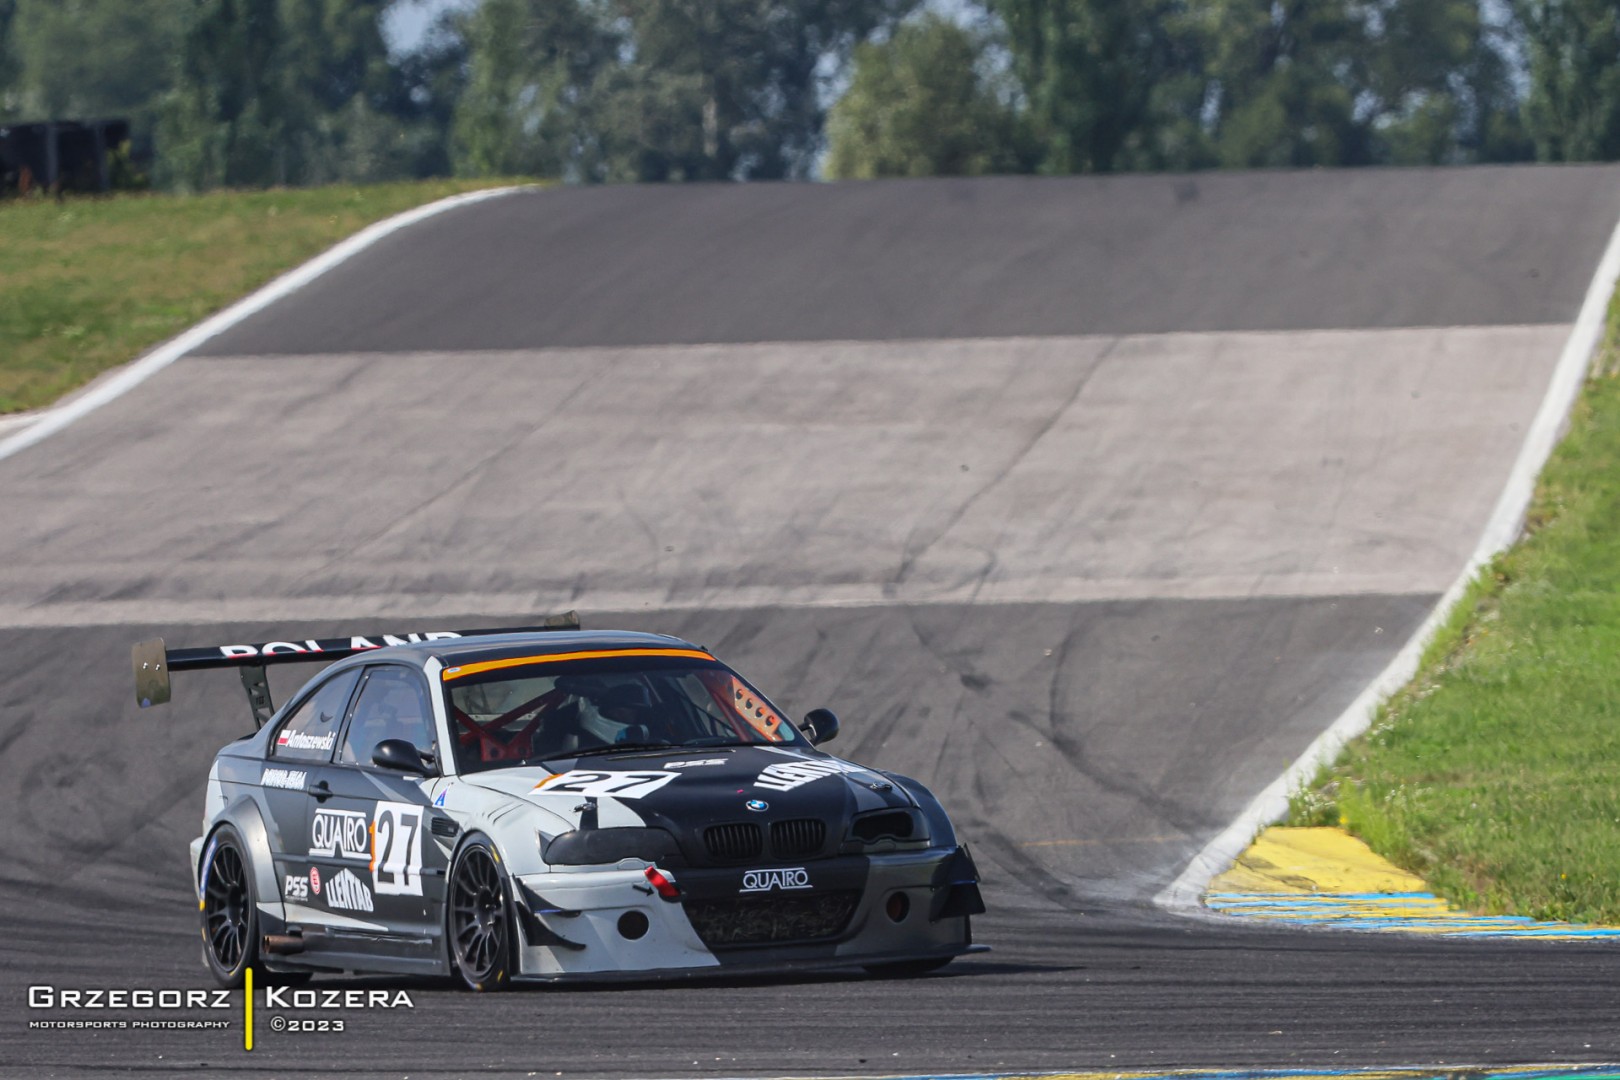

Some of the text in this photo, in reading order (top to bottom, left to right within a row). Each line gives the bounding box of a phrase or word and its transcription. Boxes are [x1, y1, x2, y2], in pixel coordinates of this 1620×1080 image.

[545, 773, 669, 794] 27
[310, 809, 369, 858] QUATRO
[377, 809, 420, 886] 27
[285, 875, 309, 897] PSS
[325, 868, 374, 912] LLENTAB
[739, 867, 813, 892] QUATRO
